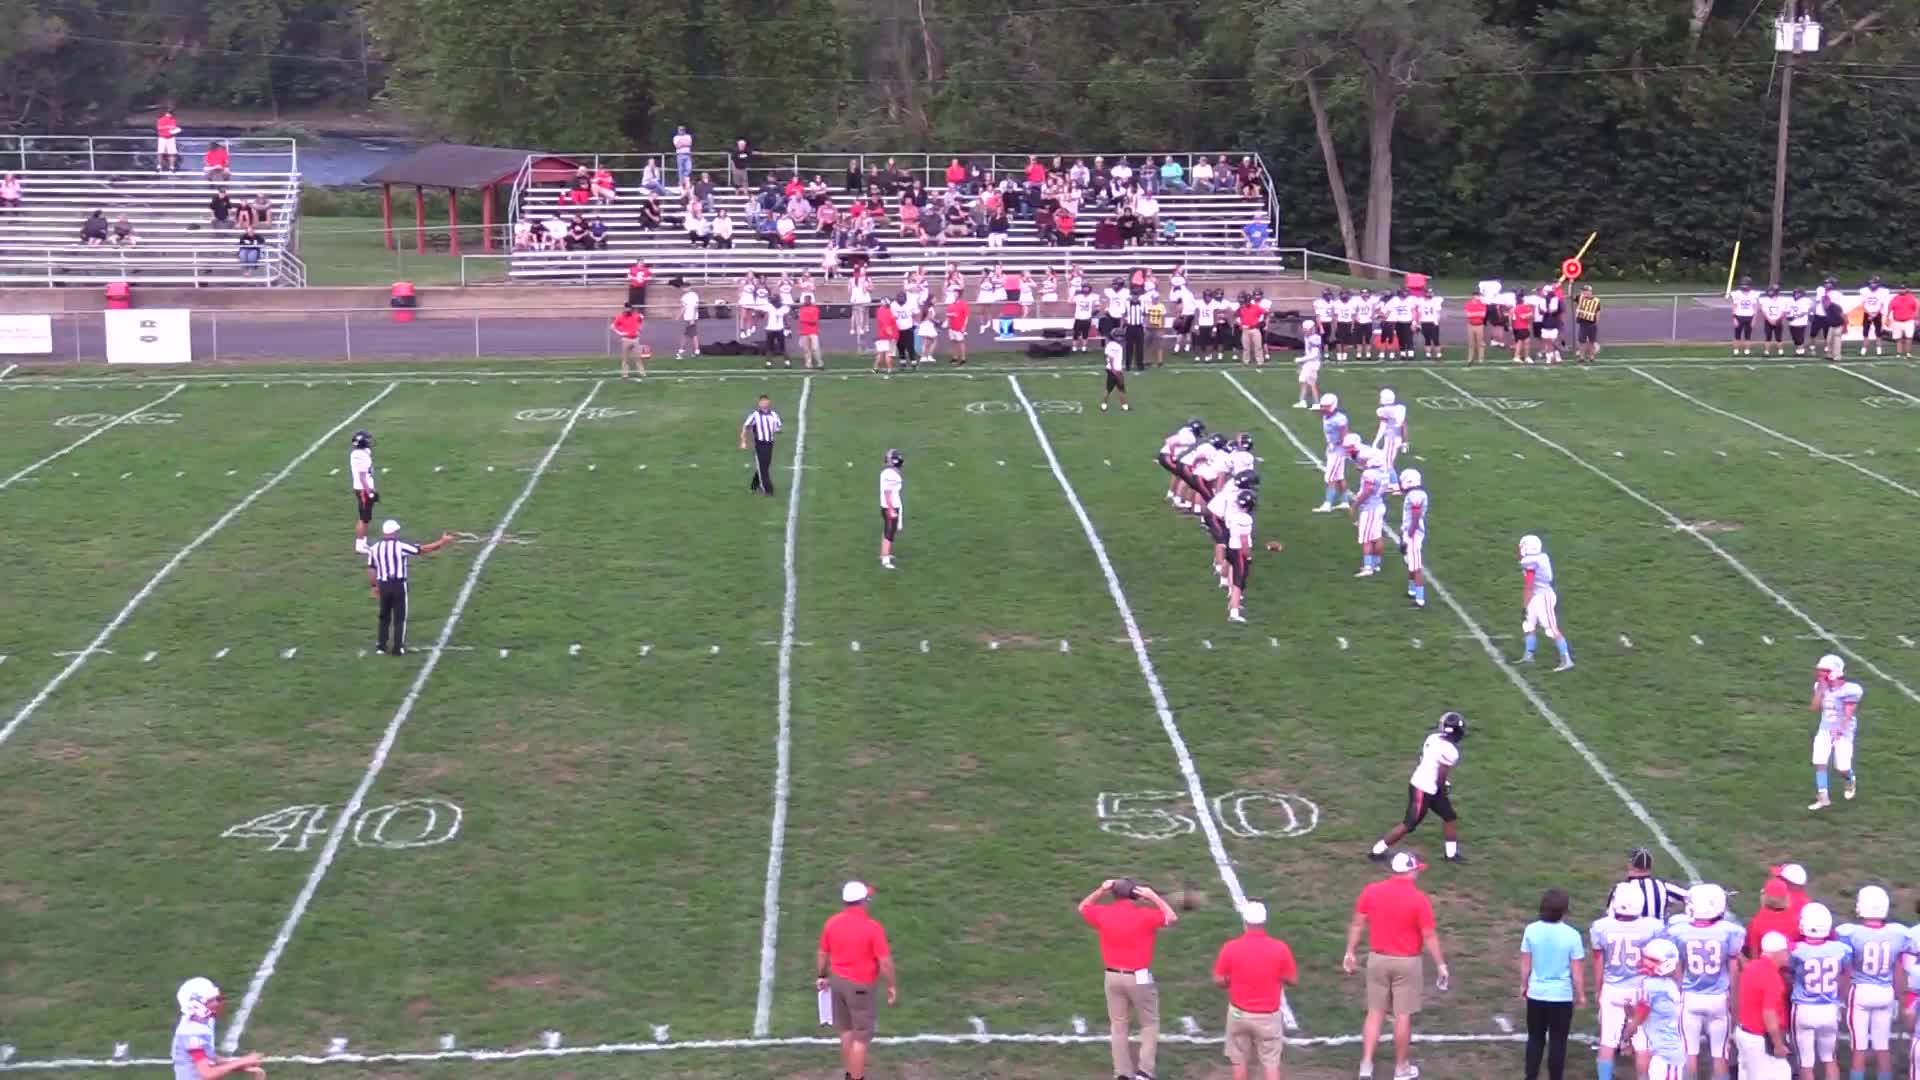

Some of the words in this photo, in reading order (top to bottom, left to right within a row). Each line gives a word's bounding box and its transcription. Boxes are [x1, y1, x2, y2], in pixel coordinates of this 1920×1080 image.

[220, 799, 463, 851] 40
[1096, 790, 1319, 839] 50
[1609, 938, 1643, 967] 75
[1687, 939, 1722, 975] 63
[1863, 940, 1890, 976] 81
[1804, 958, 1839, 994] 22
